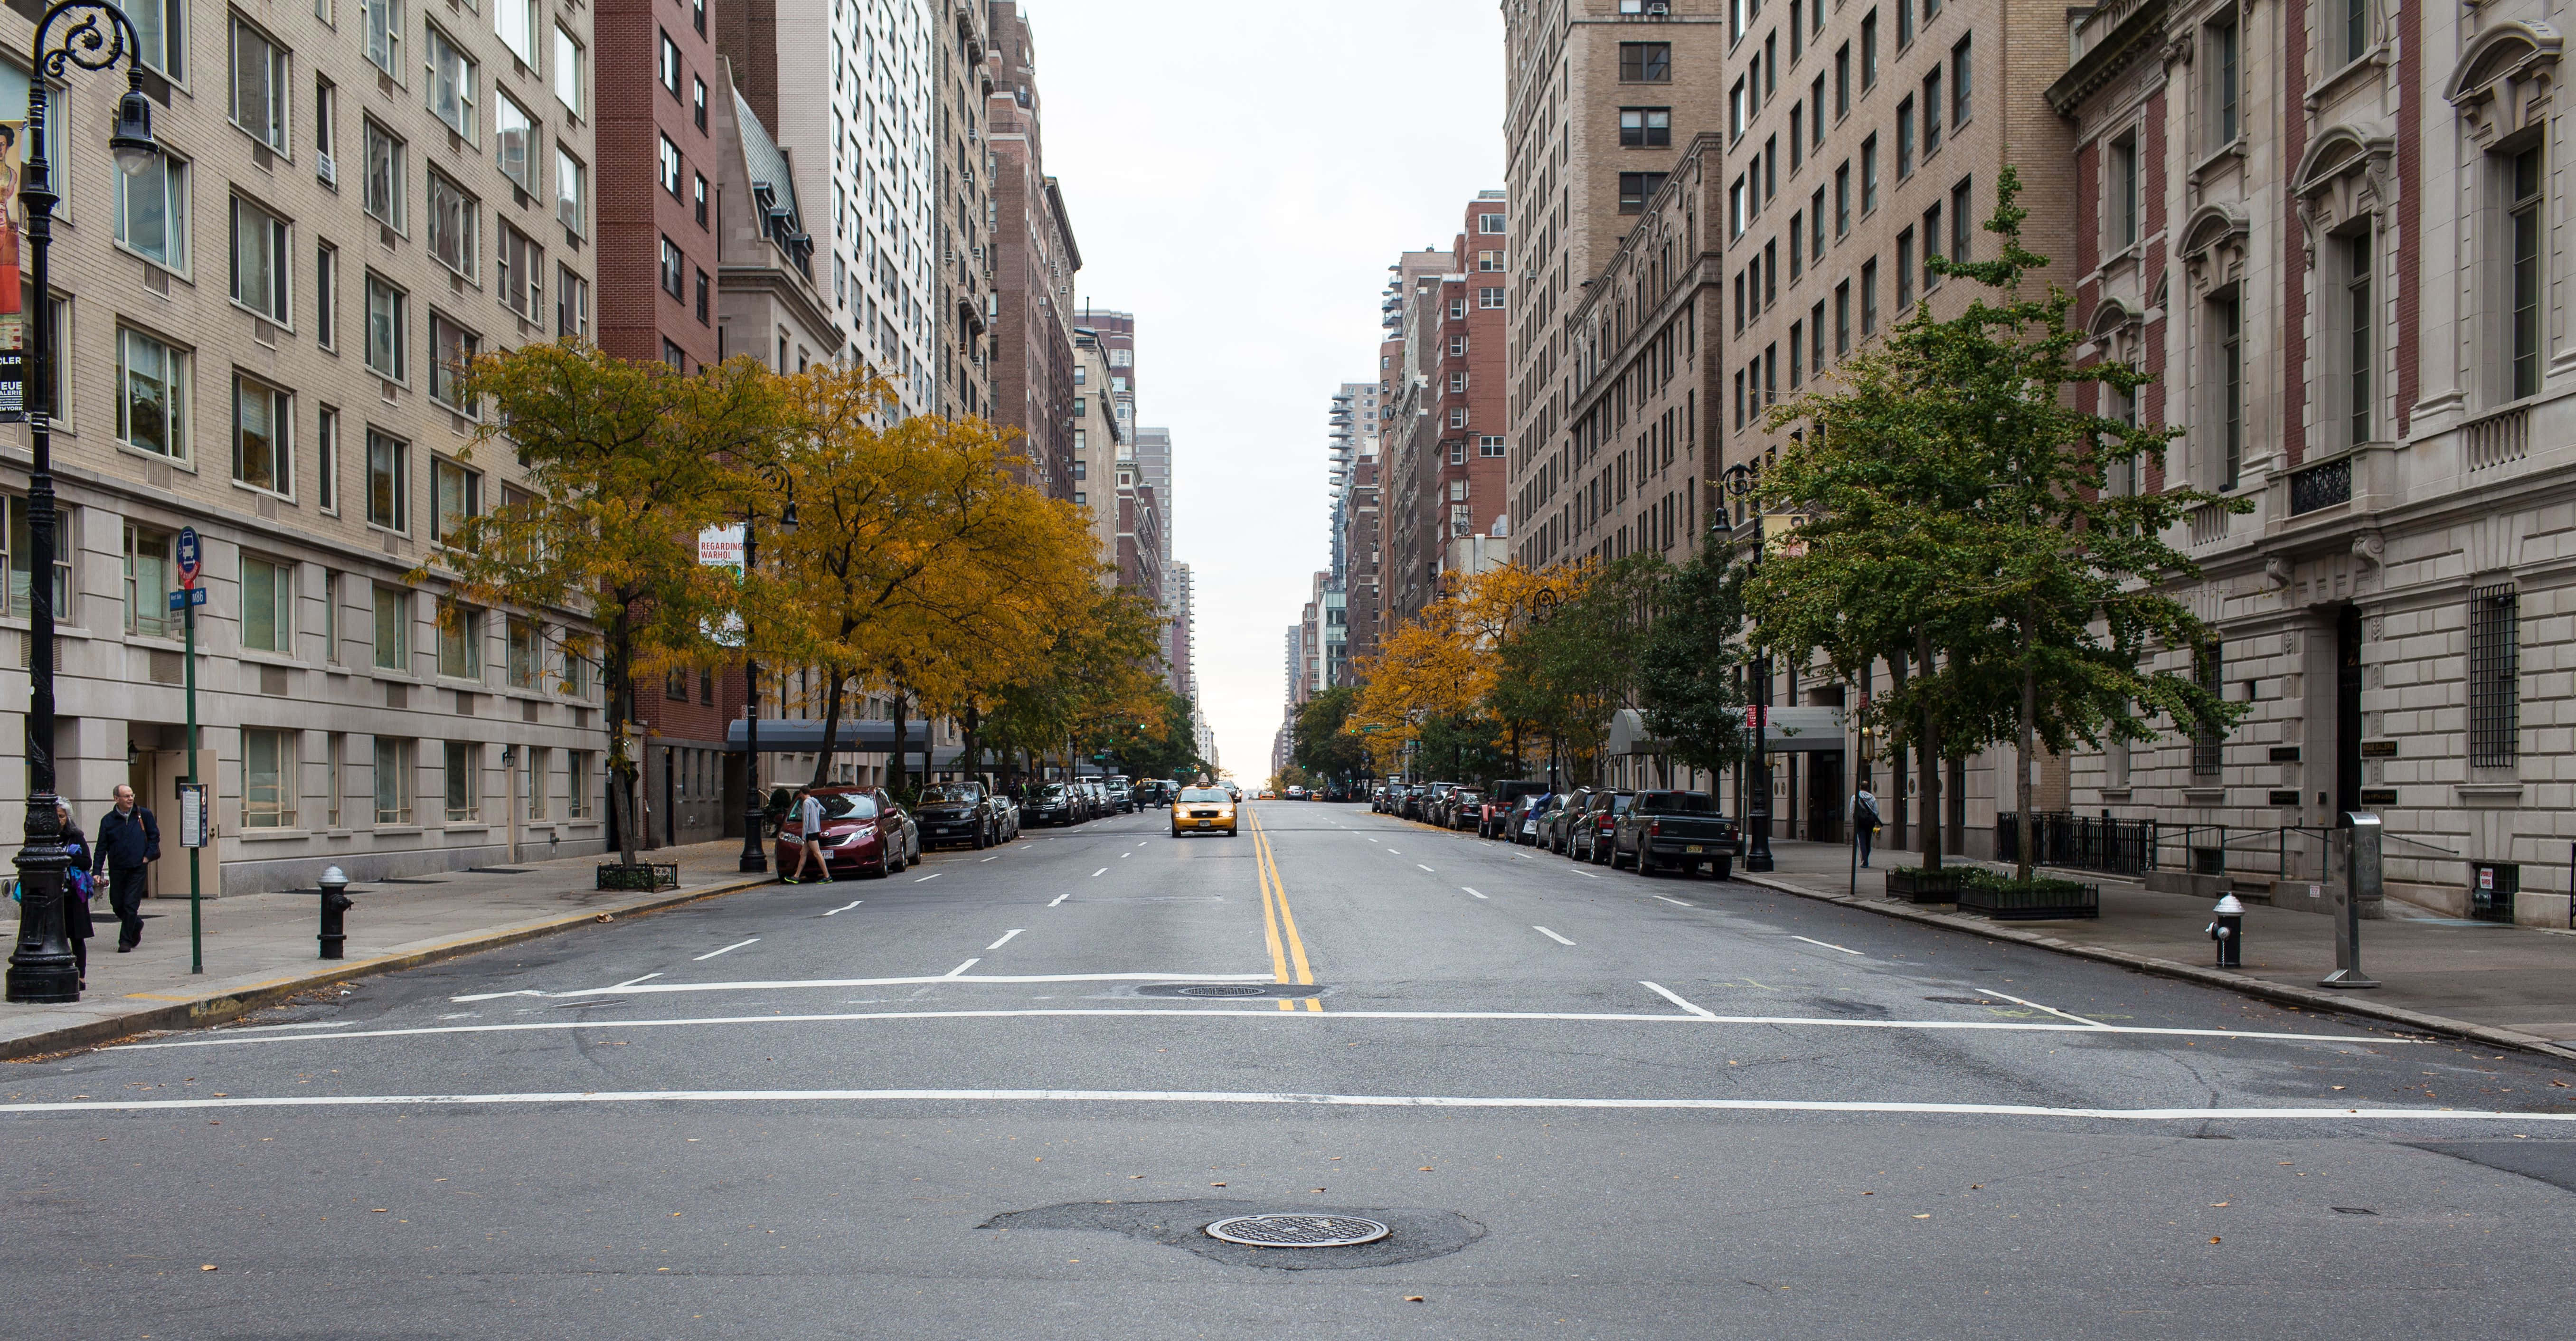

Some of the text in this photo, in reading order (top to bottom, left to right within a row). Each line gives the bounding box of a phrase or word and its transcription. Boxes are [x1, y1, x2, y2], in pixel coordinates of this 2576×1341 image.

[0, 381, 22, 390] EUE
[701, 542, 742, 550] REGARDING
[192, 590, 203, 603] M86
